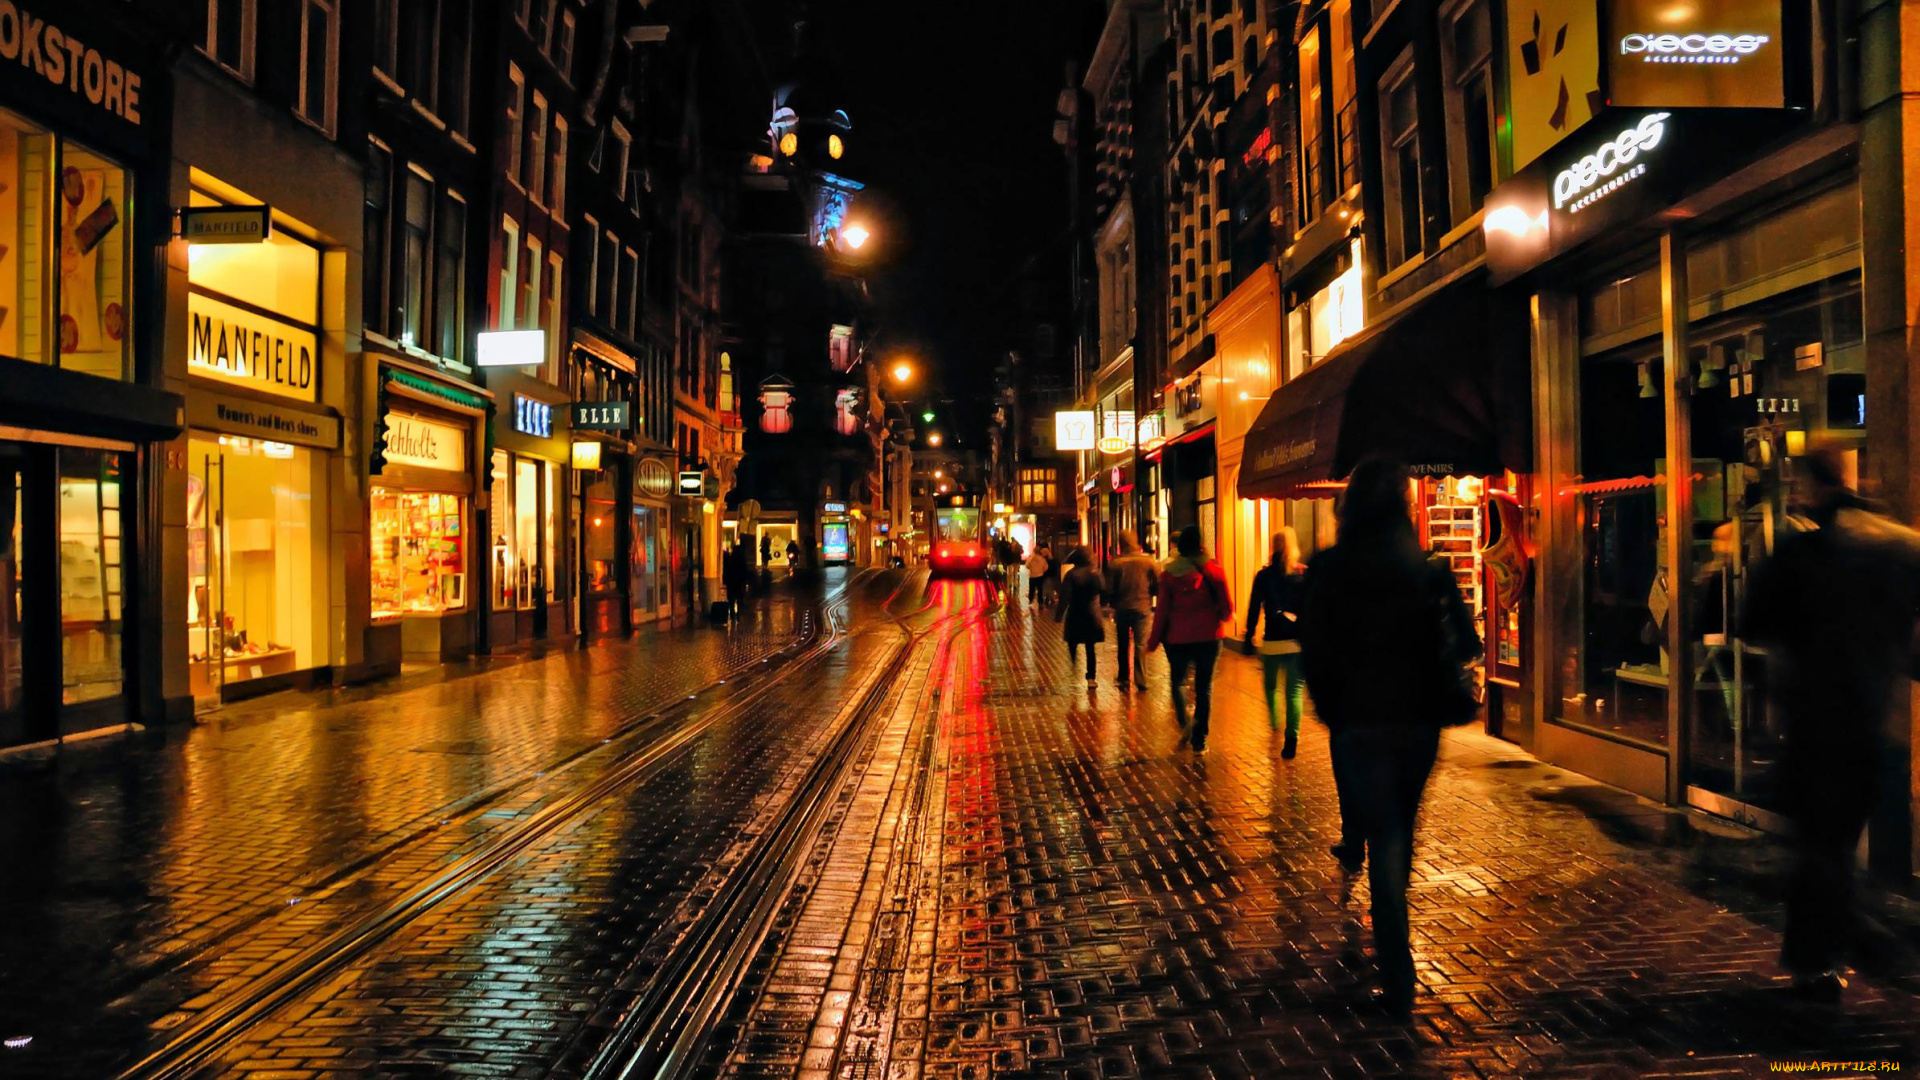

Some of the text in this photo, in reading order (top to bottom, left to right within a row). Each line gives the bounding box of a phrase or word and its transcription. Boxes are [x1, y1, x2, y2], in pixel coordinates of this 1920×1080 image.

[0, 0, 141, 125] OKSTORE
[1621, 34, 1769, 55] pieces
[1554, 112, 1671, 209] pieces
[1570, 163, 1646, 213] ACCESSORIES
[193, 220, 259, 233] MANFIELD
[192, 312, 311, 389] MANFIELD
[257, 412, 272, 428] and
[297, 419, 318, 437] shoes
[580, 407, 621, 423] ELLE
